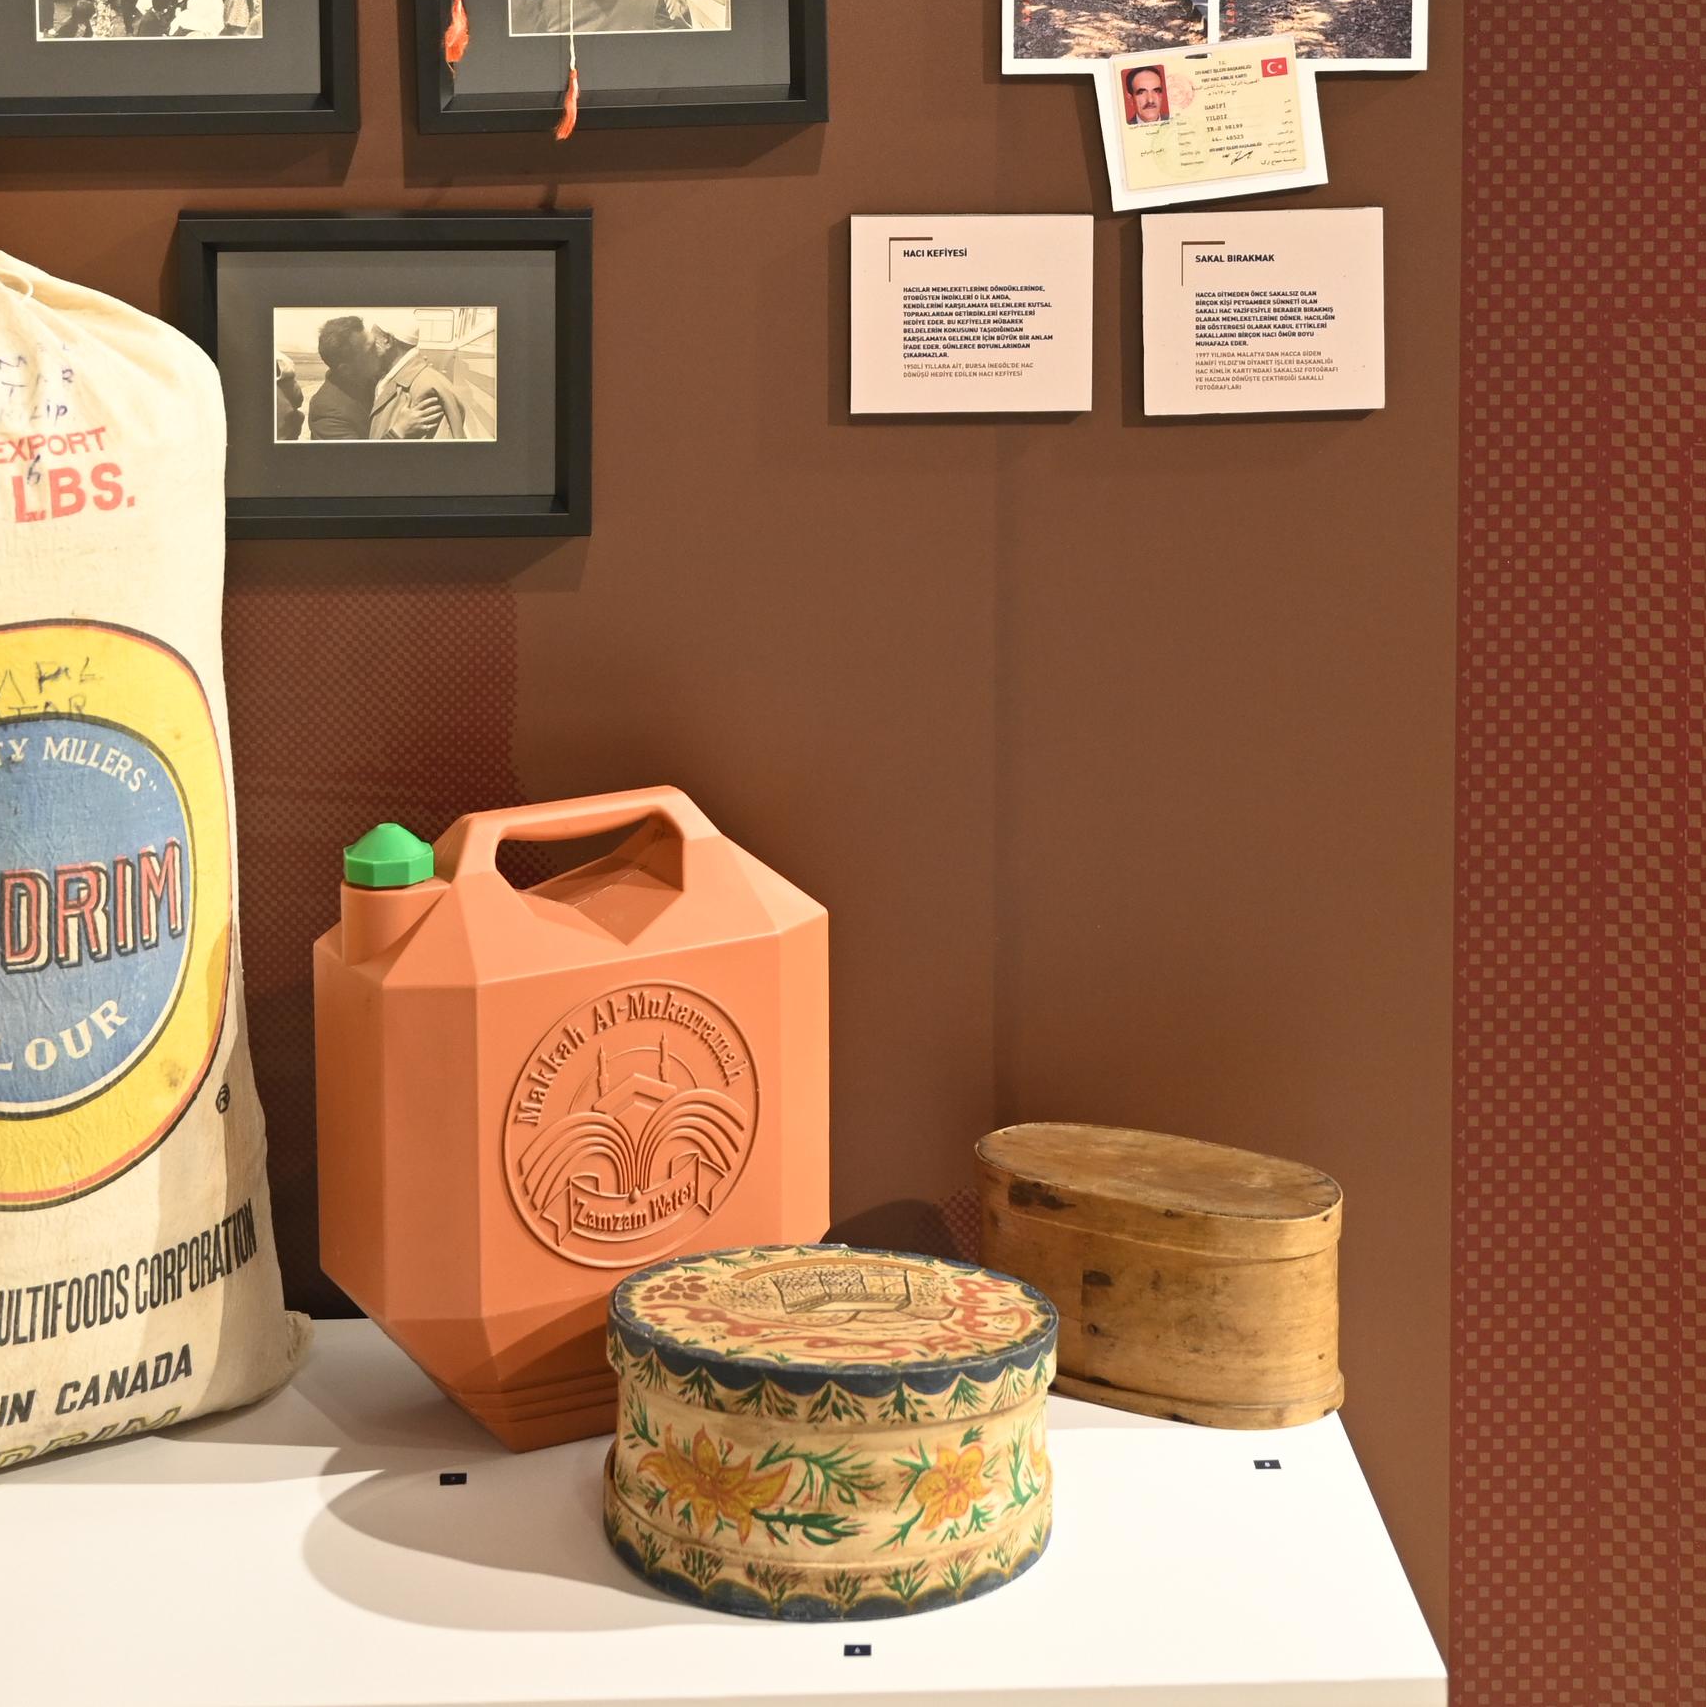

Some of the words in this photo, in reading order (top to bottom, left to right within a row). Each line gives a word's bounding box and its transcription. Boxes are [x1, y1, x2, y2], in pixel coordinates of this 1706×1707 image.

[927, 248, 967, 257] KEFİYESİ
[1195, 255, 1225, 263] SAKAL
[1227, 254, 1275, 262] BIRAKMAK
[12, 462, 135, 524] LBS.
[515, 1023, 589, 1128] Makkah
[592, 991, 749, 1087] Al-Mukarramah
[573, 1197, 650, 1232] Zamzam
[649, 1180, 695, 1222] Water
[133, 1198, 259, 1315] CORPORATION
[54, 1343, 193, 1417] CANADA
